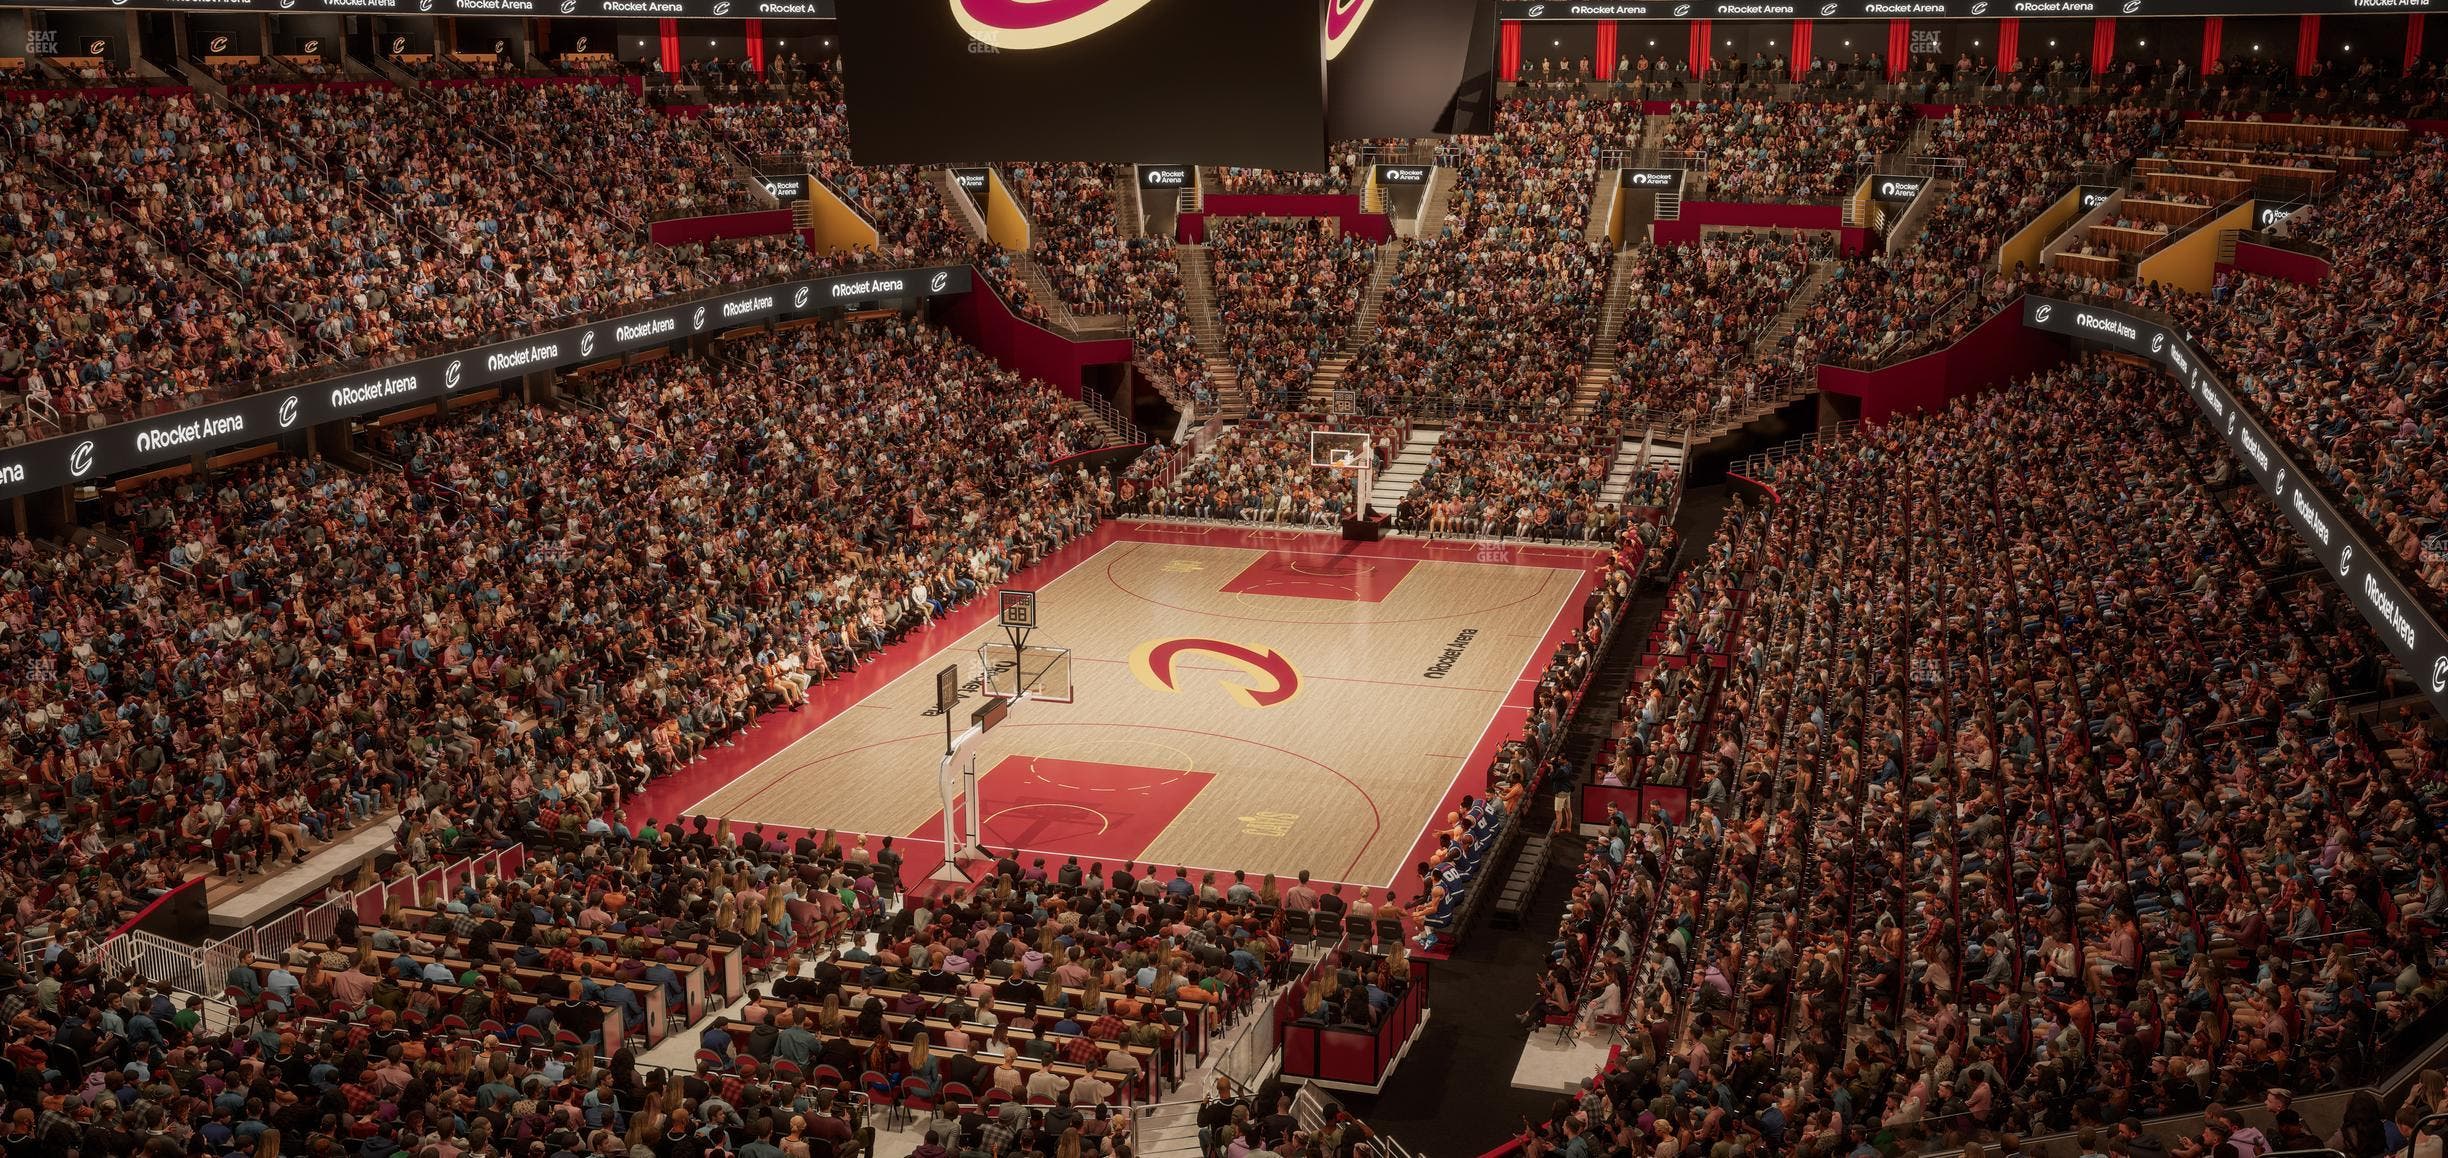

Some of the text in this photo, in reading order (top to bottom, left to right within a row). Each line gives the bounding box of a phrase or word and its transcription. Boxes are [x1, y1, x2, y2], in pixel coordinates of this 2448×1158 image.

[464, 0, 533, 10] Rocket Arena
[612, 0, 683, 12] Rocket Arena
[769, 3, 806, 13] Rocket
[1580, 5, 1647, 15] Rocket Arena
[1727, 4, 1794, 14] Rocket Arena
[1875, 3, 1945, 13] Rocket Arena
[2024, 1, 2094, 12] Rocket Arena
[1895, 182, 1919, 190] Rocket
[840, 279, 904, 297] Rocket Arena
[729, 296, 773, 317] Rocket Arena
[623, 318, 675, 342] Rocket Arena
[2086, 314, 2137, 341] Rocket Arena
[496, 344, 559, 371] Rocket Arena
[342, 375, 418, 405] Rocket Arena
[150, 414, 244, 450] Rocket Arena
[2297, 491, 2330, 546] Rocket Arena
[2369, 577, 2416, 650] Rocket Arena
[1427, 628, 1479, 672] Rocket Arena
